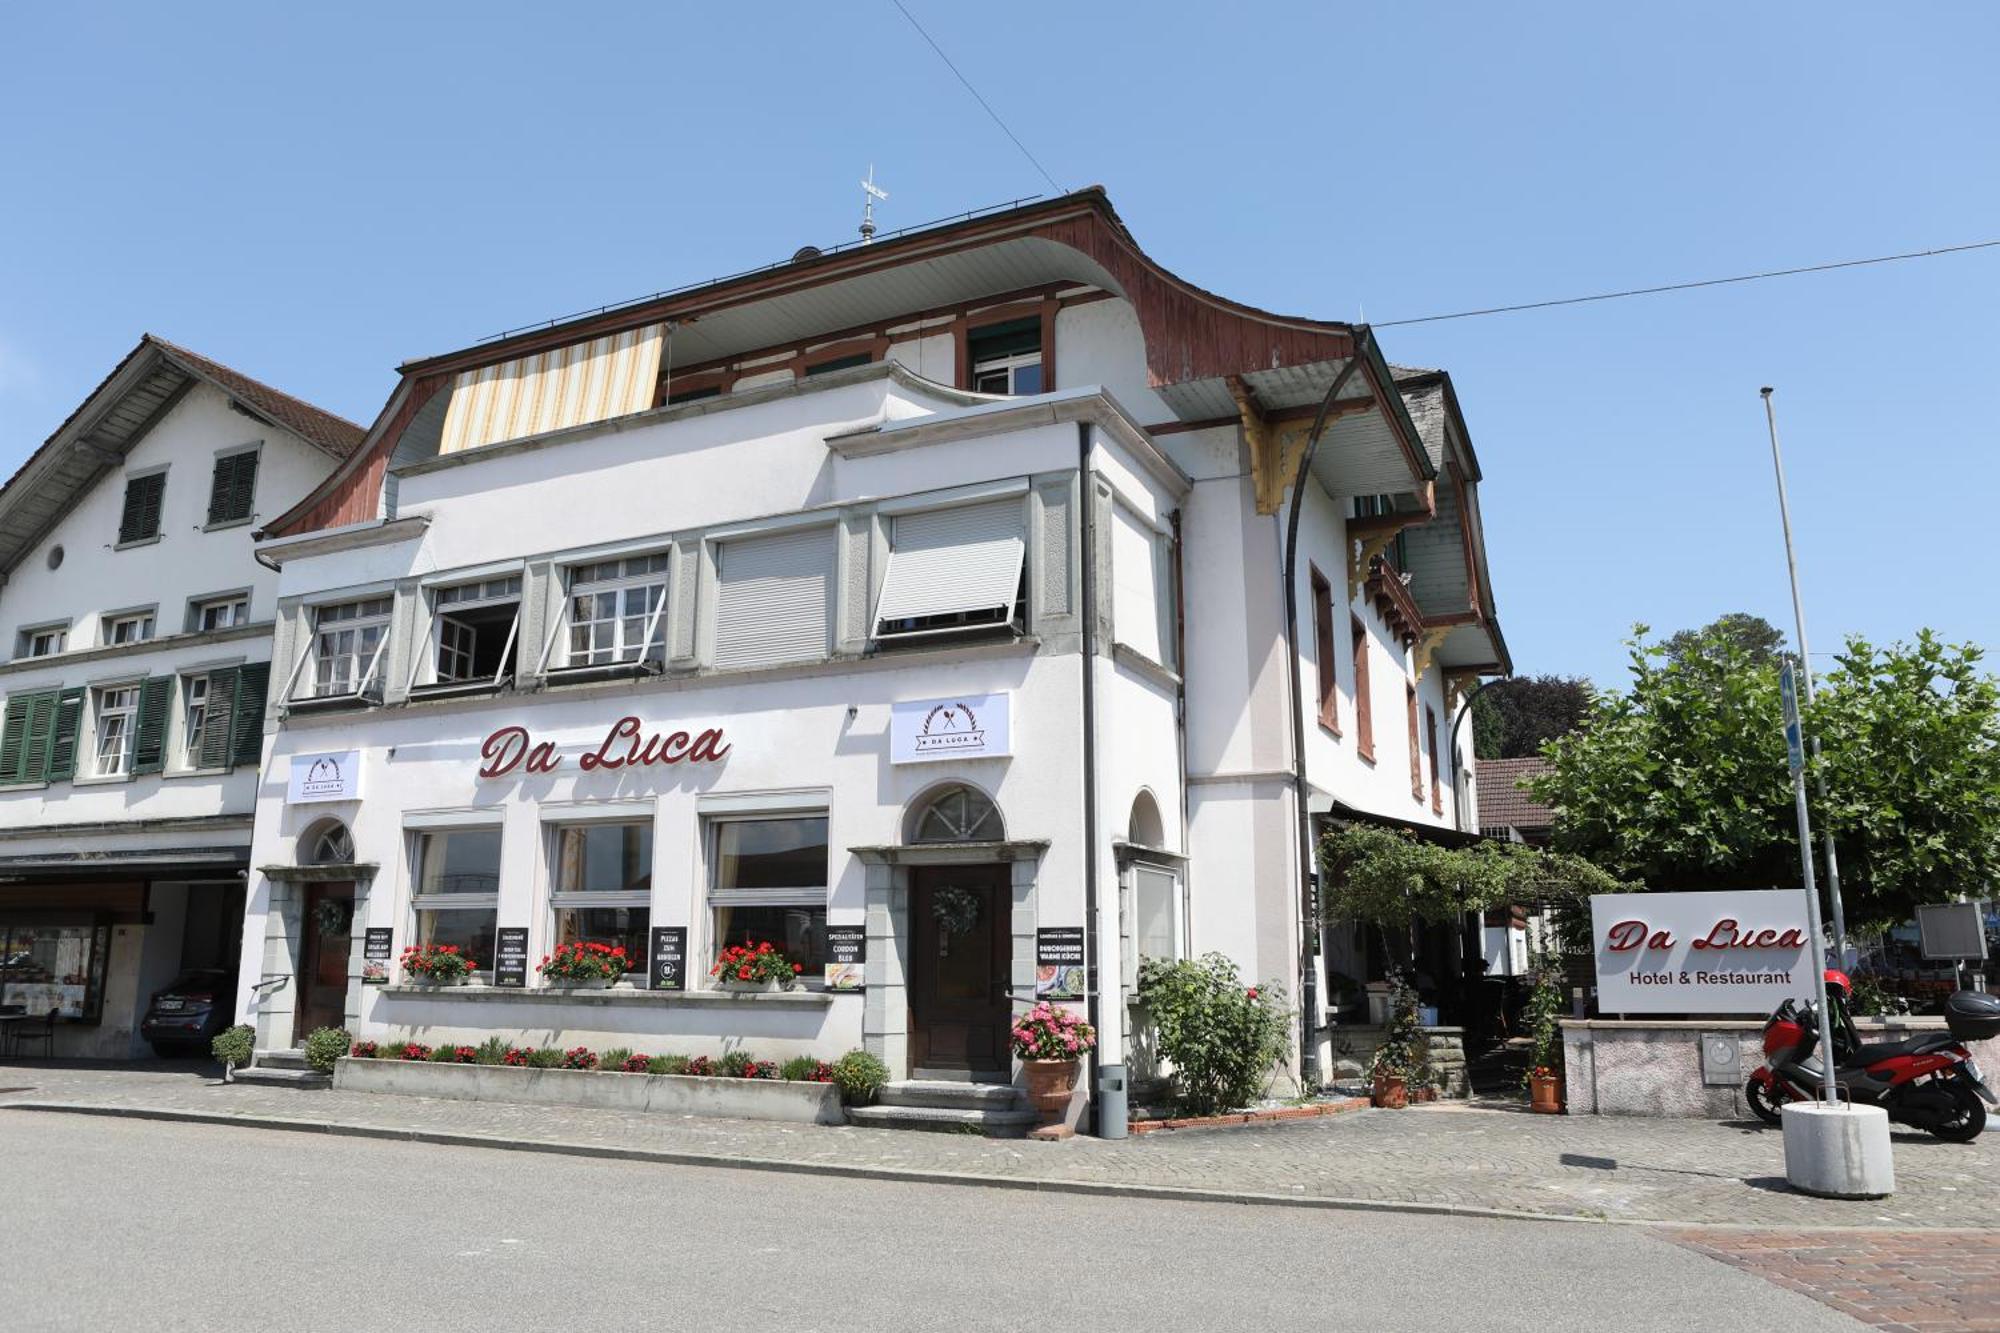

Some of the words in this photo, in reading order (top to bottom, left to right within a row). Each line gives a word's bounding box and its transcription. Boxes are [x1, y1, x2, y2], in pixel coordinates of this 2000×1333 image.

[480, 726, 562, 778] Da
[580, 716, 732, 770] Luca
[1608, 920, 1677, 952] Da
[1692, 918, 1809, 950] Luca
[832, 945, 858, 953] CORDON
[1630, 972, 1673, 985] Hotel
[1679, 972, 1691, 985] &
[1697, 971, 1792, 984] Restaurant
